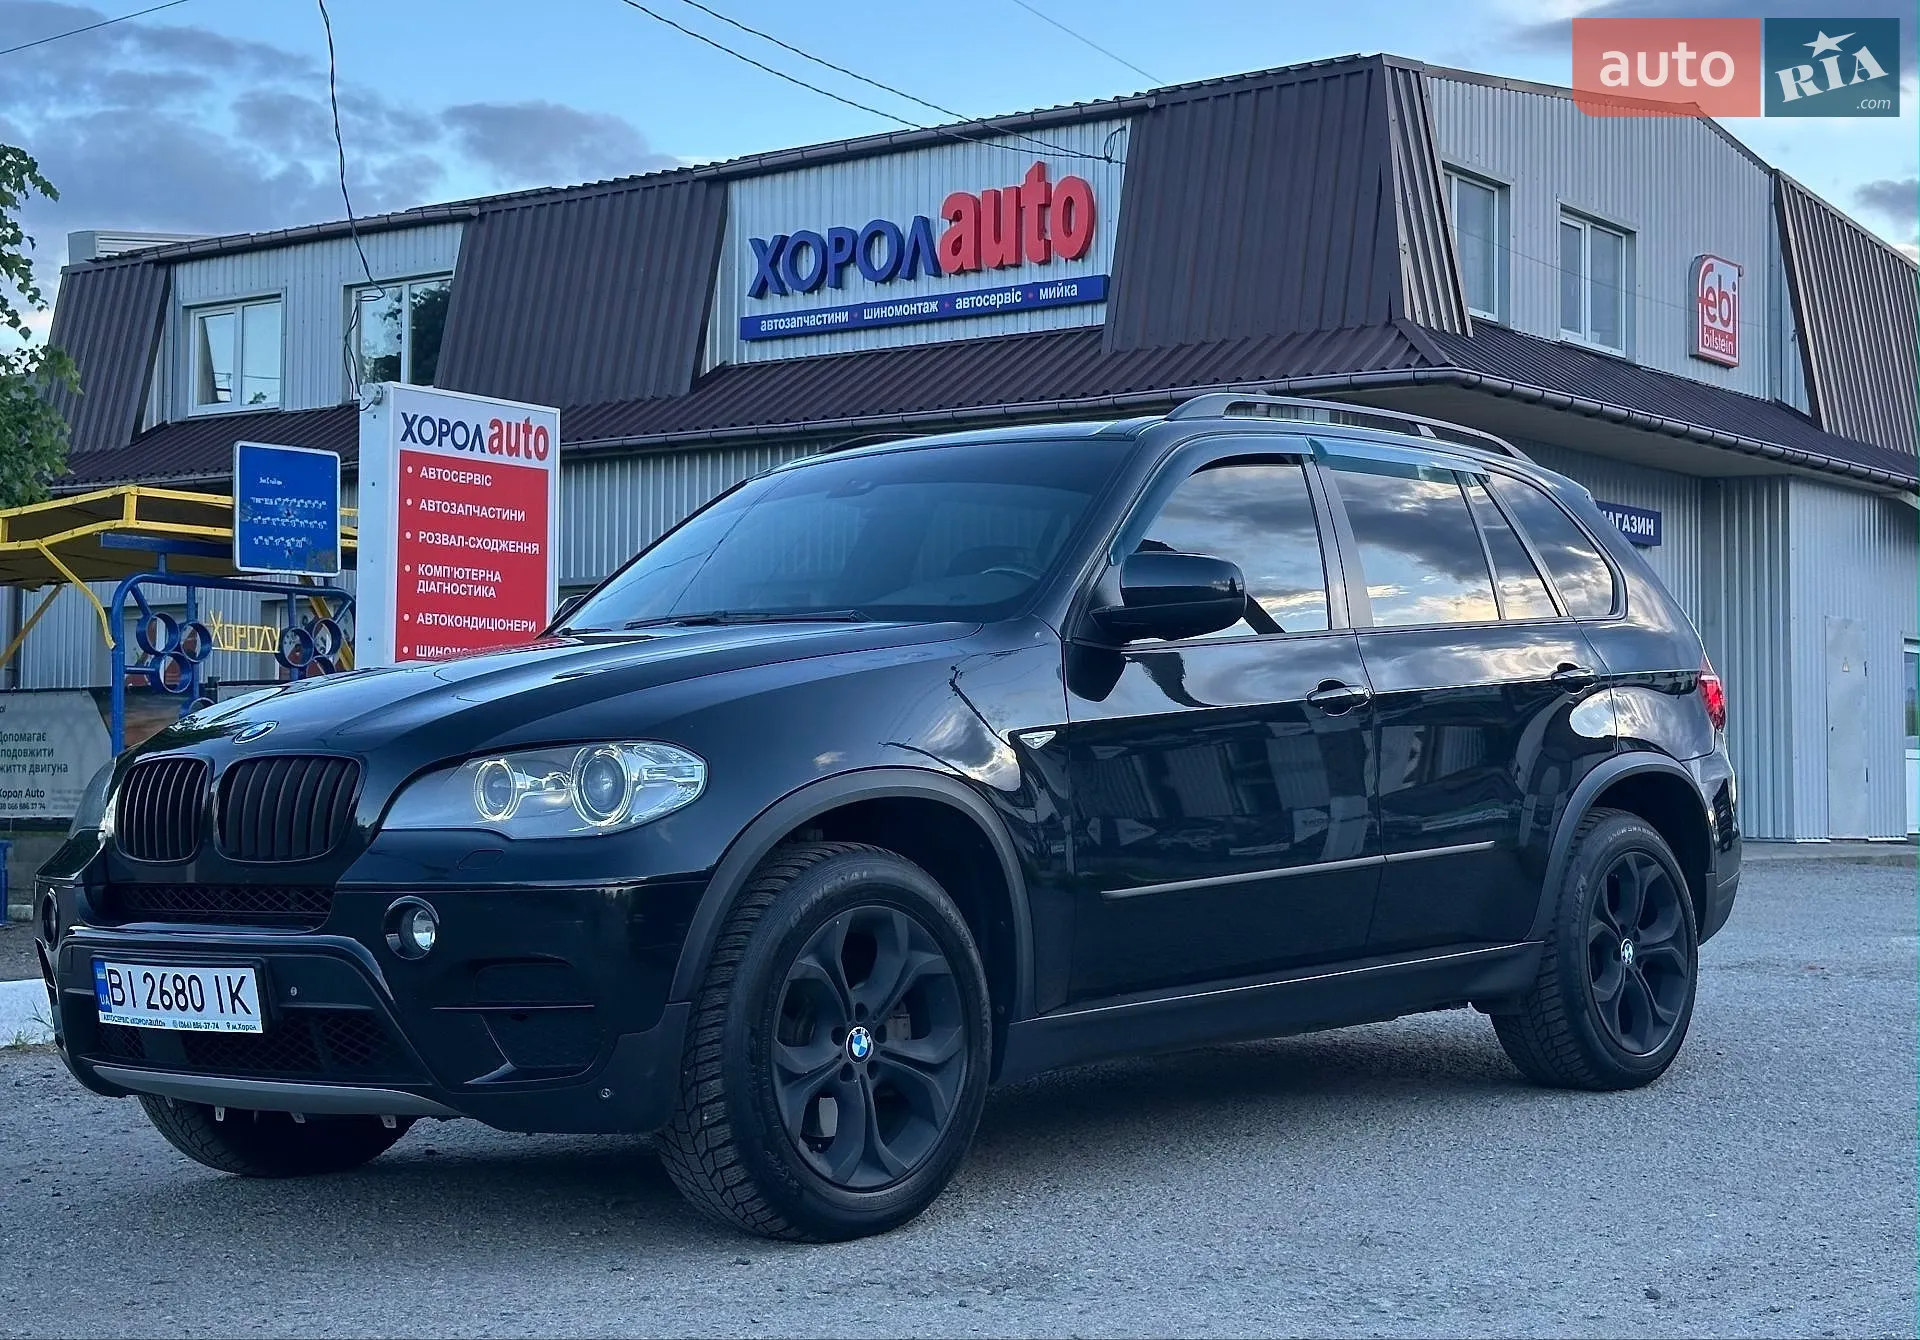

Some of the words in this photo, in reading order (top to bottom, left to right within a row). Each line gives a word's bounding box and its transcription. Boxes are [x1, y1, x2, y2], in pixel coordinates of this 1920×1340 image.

[760, 311, 849, 332] автозапчастини
[863, 300, 939, 321] шиномонтаж
[955, 288, 1022, 310] автосервіс
[1039, 282, 1078, 300] мийка
[1697, 263, 1737, 335] febi
[1703, 325, 1734, 355] bilstein
[420, 466, 493, 487] АВТОСЕРВІС
[419, 499, 526, 522] АВТОЗАПЧАСТИНИ
[1602, 510, 1655, 536] АГАЗИН
[418, 531, 540, 555] РОЗВАЛ-СХОДЖЕННЯ
[418, 564, 502, 583] КОМП'ЮТЕРНА
[417, 580, 497, 598] ДІАГНОСТИКА
[416, 612, 537, 633] АВТОКОНДИЦІОНЕРИ
[28, 763, 69, 776] двигуна
[24, 788, 45, 798] Auto
[100, 993, 111, 1007] UA
[107, 969, 137, 1008] BI
[142, 972, 205, 1013] 2680
[214, 975, 252, 1015] IK
